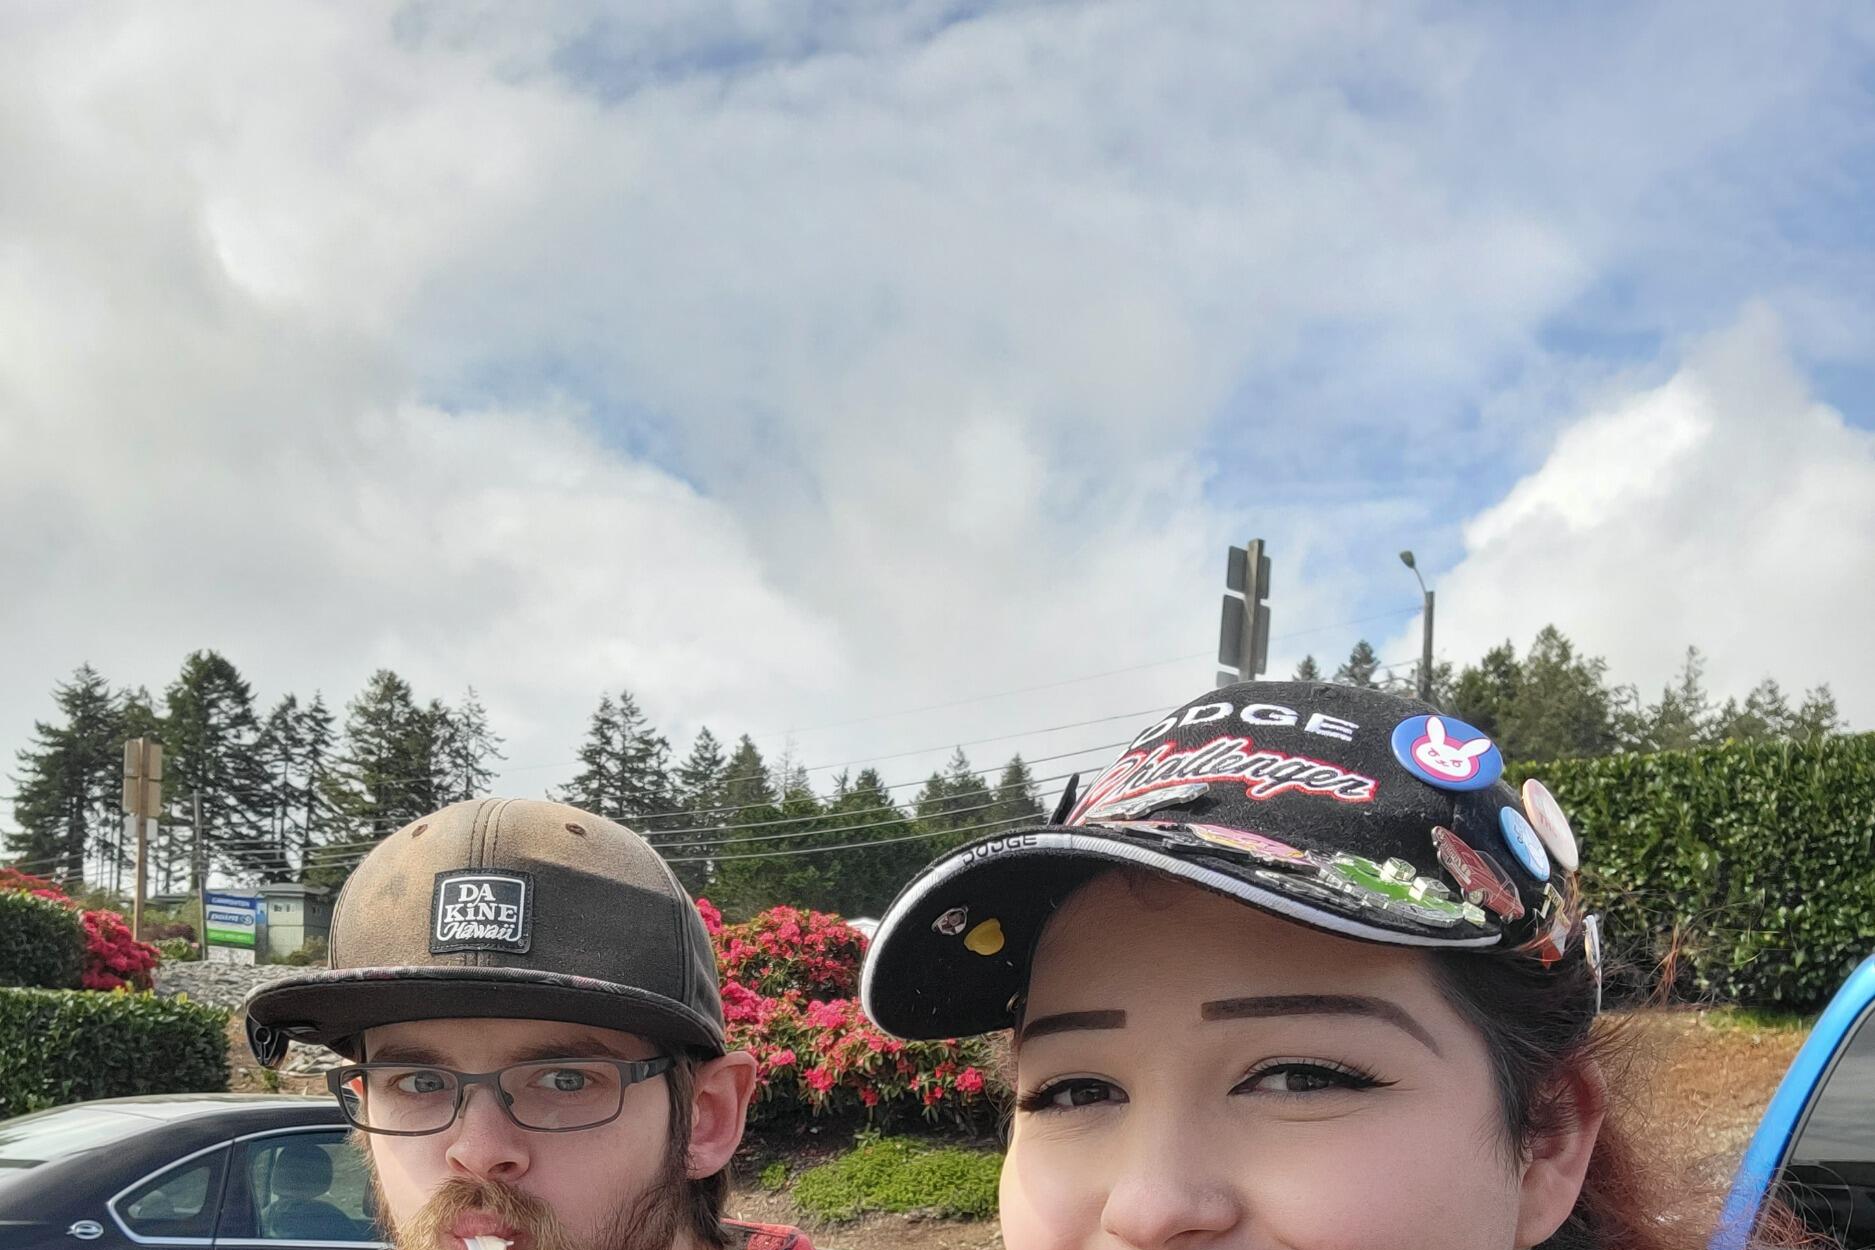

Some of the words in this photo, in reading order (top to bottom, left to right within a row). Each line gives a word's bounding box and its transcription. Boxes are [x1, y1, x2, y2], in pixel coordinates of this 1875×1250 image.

[1129, 702, 1360, 750] ODGE
[458, 883, 496, 907] DA
[443, 921, 516, 941] Hawaii
